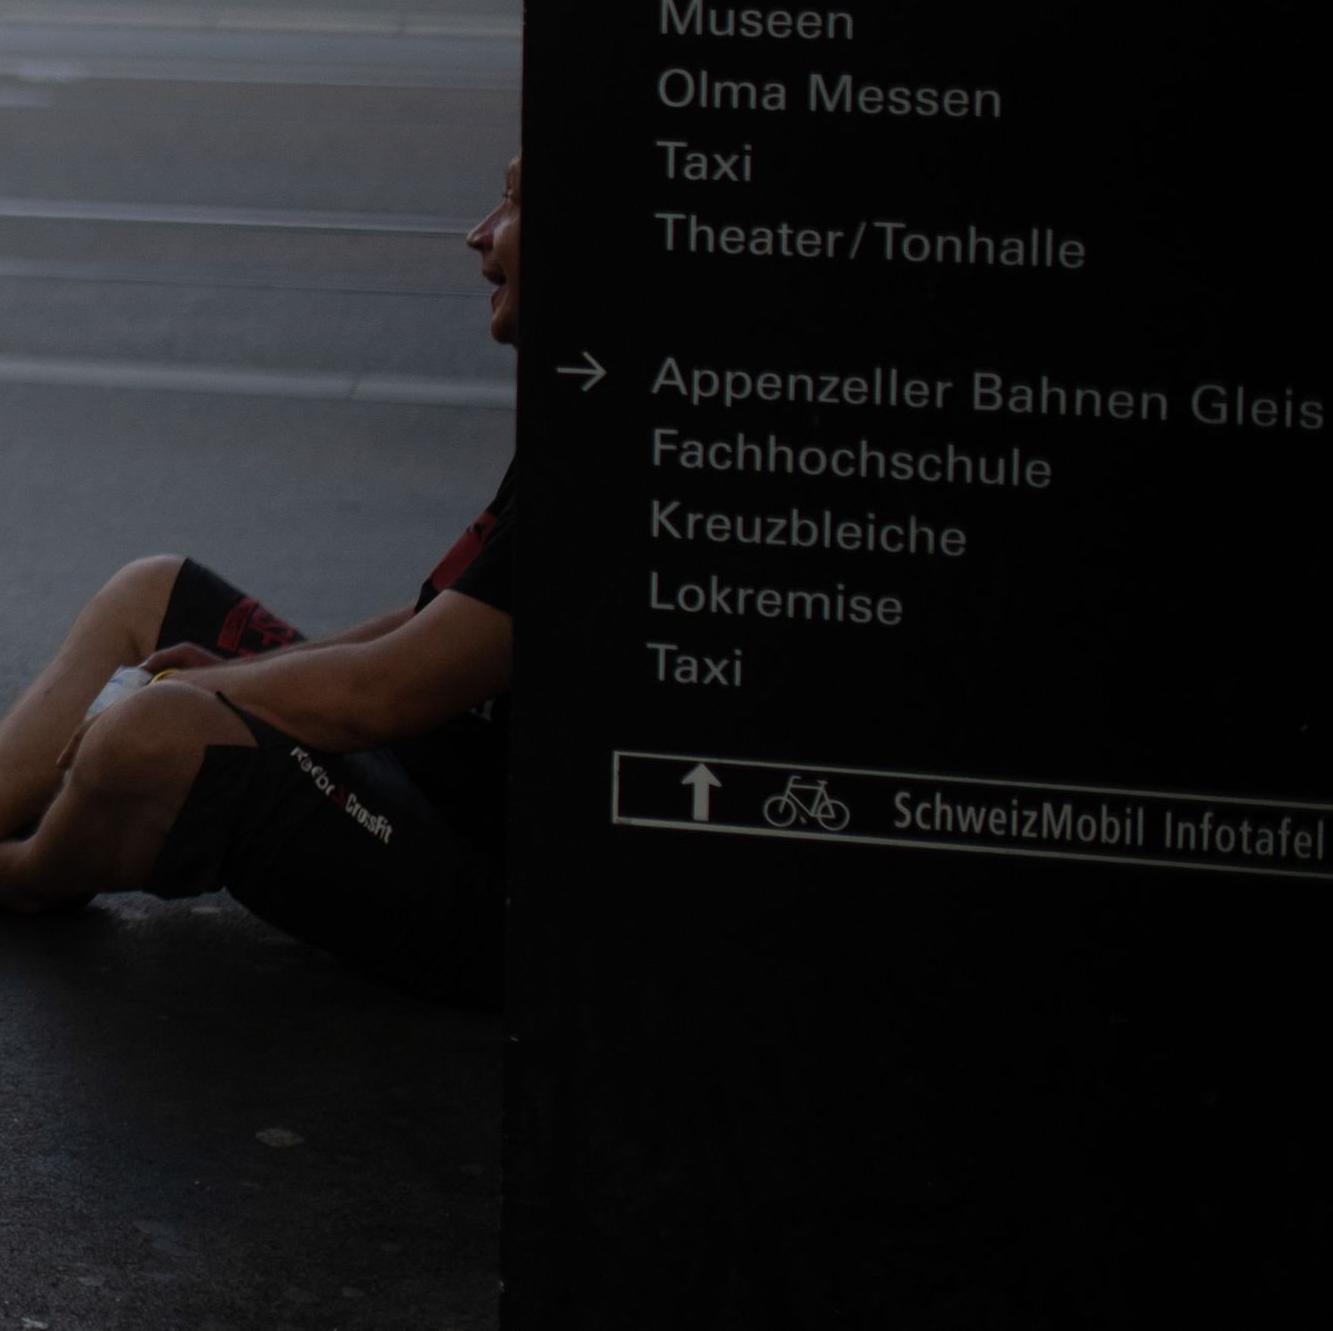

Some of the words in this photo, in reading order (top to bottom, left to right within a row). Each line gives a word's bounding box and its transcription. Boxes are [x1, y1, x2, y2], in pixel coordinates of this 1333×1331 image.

[657, 68, 786, 111] Olma
[809, 73, 1000, 117] Messen
[655, 140, 752, 181] Taxi
[651, 356, 953, 408] Appenzeller
[973, 371, 1168, 420] Bahnen
[1191, 384, 1323, 429] Gleis
[652, 428, 1051, 488] Fachhochschule
[651, 499, 966, 556] Kreuzbleiche
[650, 571, 902, 625] Lokremise
[646, 642, 742, 686] Taxi
[893, 791, 1145, 847] SchweizMobil
[1165, 811, 1325, 860] Infotafel
